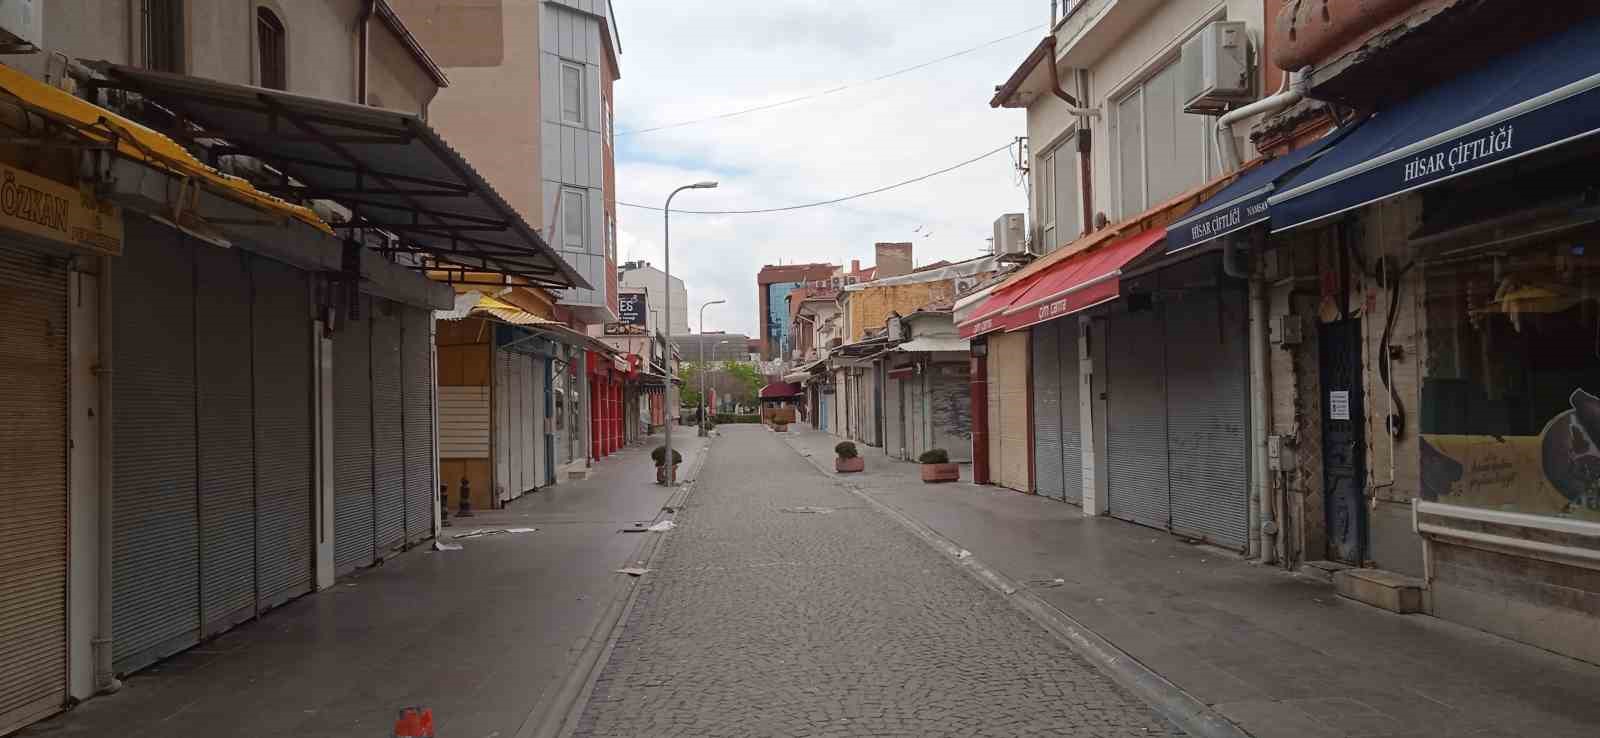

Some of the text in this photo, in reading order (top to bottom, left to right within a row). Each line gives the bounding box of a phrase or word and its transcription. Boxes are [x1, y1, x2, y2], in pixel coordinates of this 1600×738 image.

[1405, 125, 1513, 181] HİSAR ÇİFTLİĞİ
[1, 175, 70, 232] ÖZKAN
[1191, 207, 1241, 240] HİSAR ÇİFTLİĞİ
